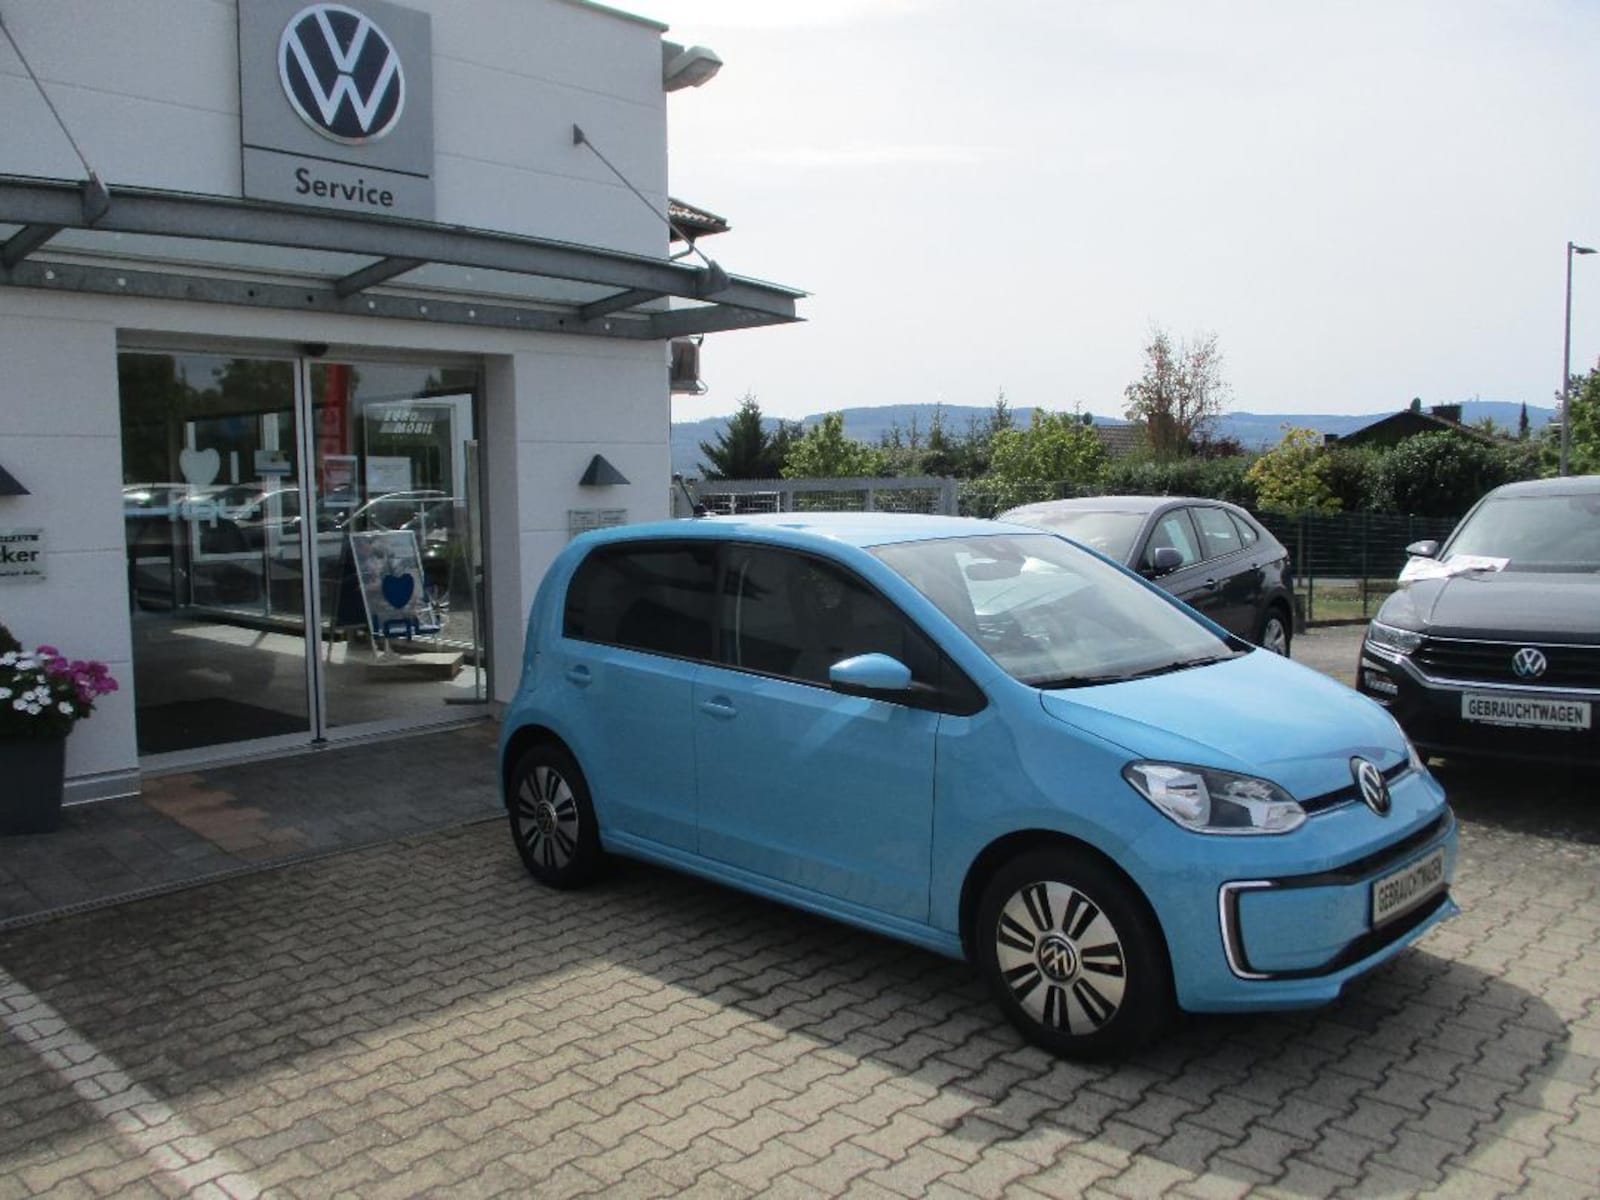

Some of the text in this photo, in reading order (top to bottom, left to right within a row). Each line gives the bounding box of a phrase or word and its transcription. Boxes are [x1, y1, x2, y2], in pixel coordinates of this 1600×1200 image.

[279, 4, 404, 143] VW
[295, 167, 394, 207] Service
[1468, 699, 1584, 723] GEBRAUCHTWAGEN
